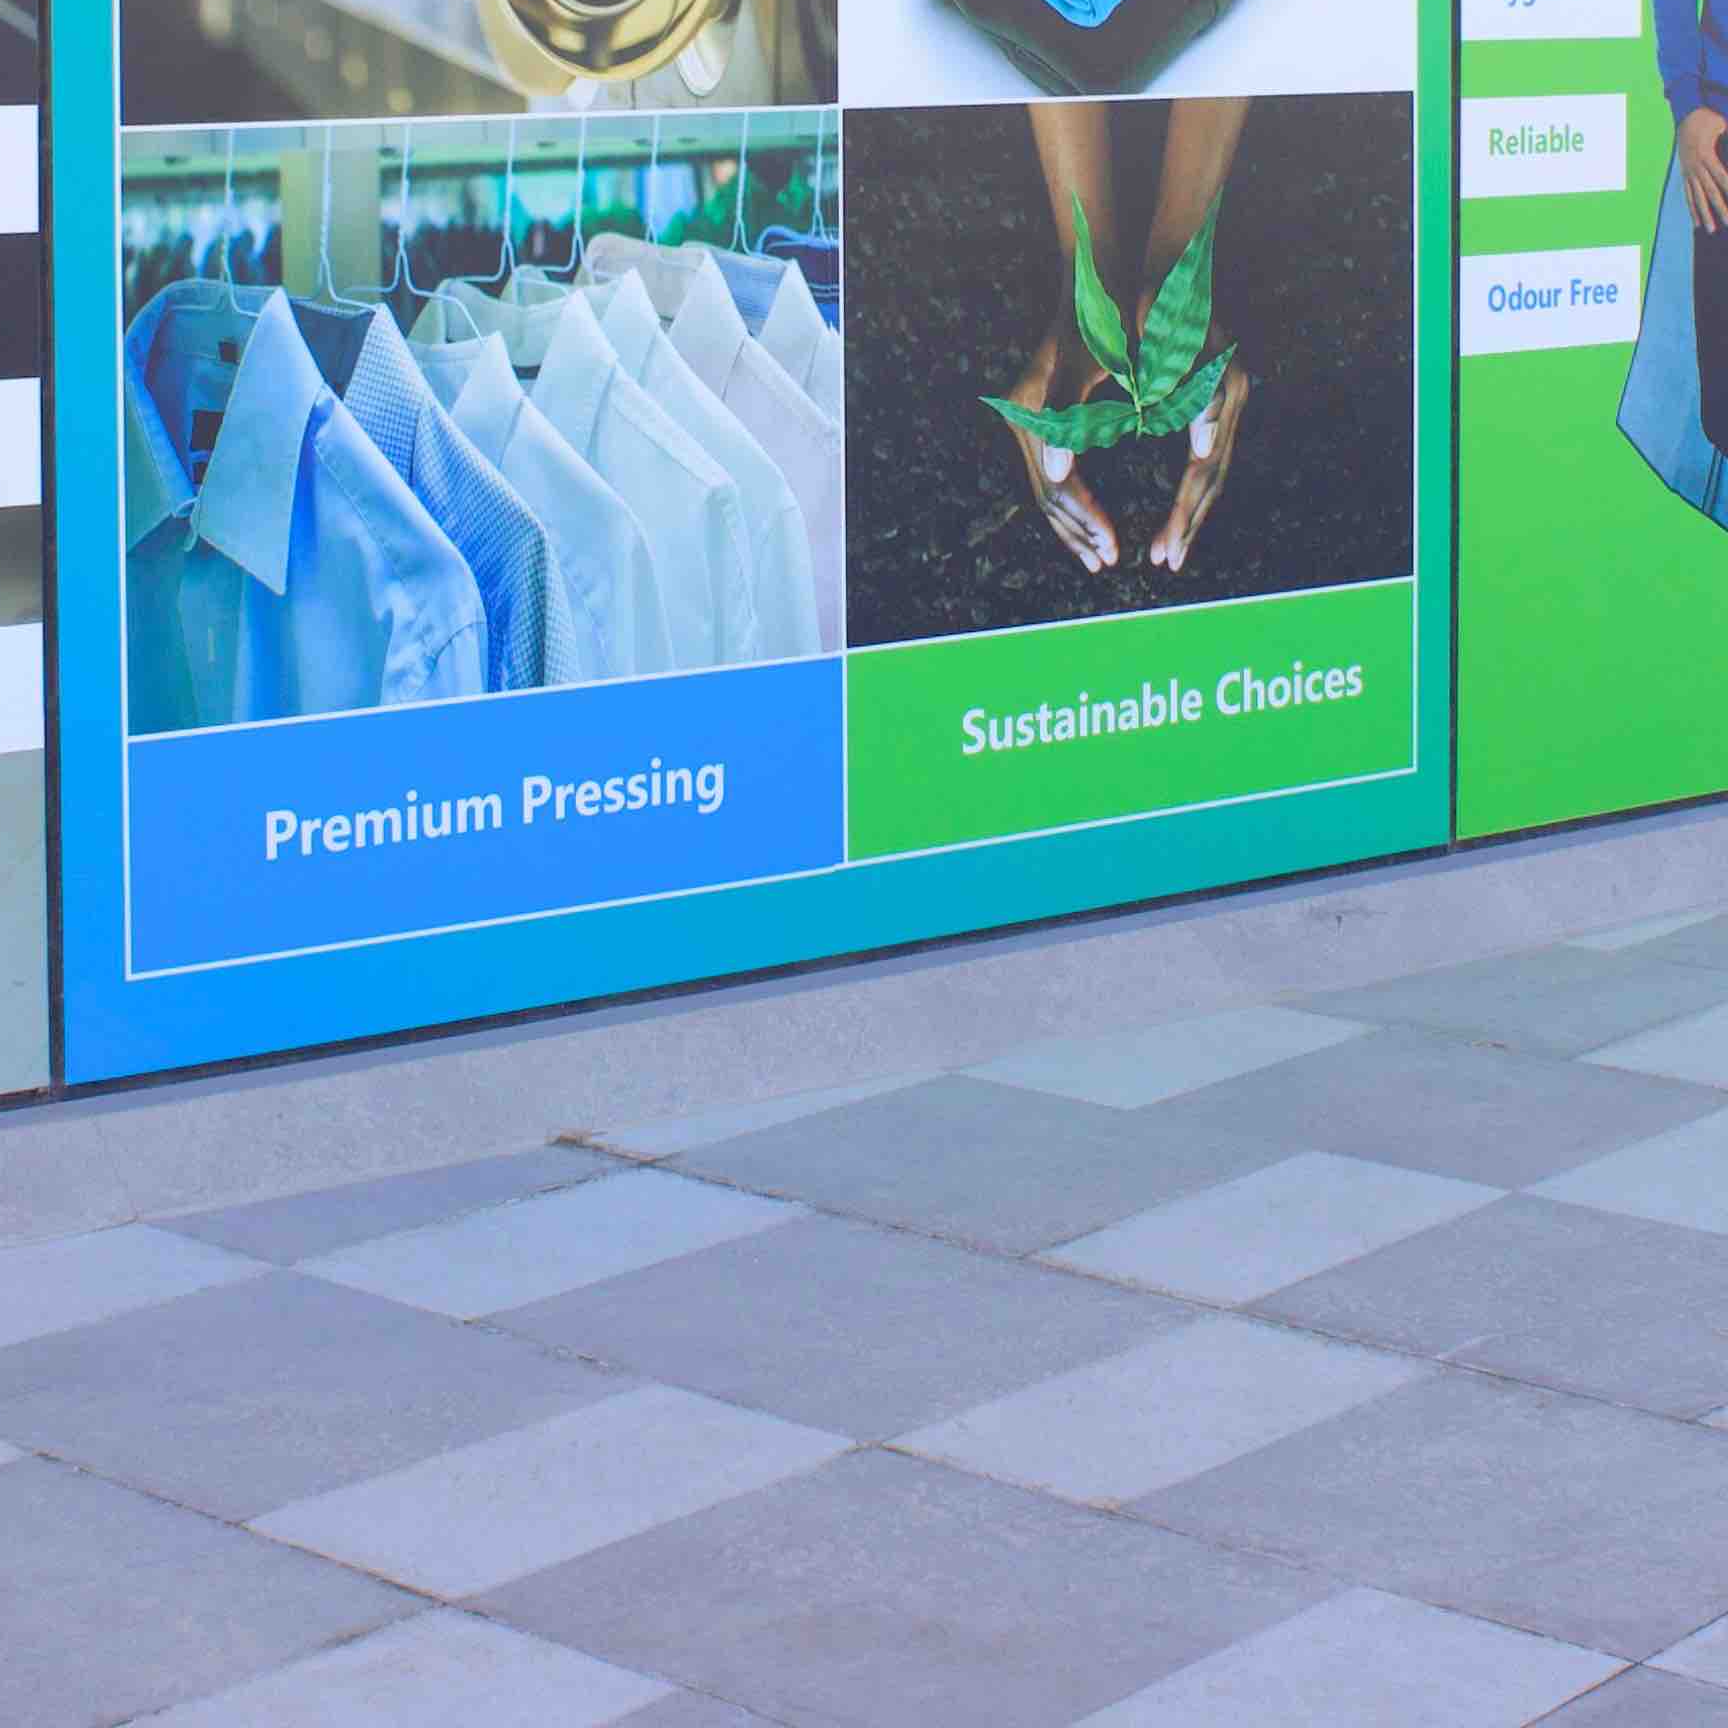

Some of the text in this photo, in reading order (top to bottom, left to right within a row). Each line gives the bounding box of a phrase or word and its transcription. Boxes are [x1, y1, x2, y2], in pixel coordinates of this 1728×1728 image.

[1488, 124, 1585, 157] Reliable
[1487, 278, 1619, 314] Odour Free
[961, 659, 1365, 757] Sustainable Choices
[264, 756, 726, 861] Premium Pressing
